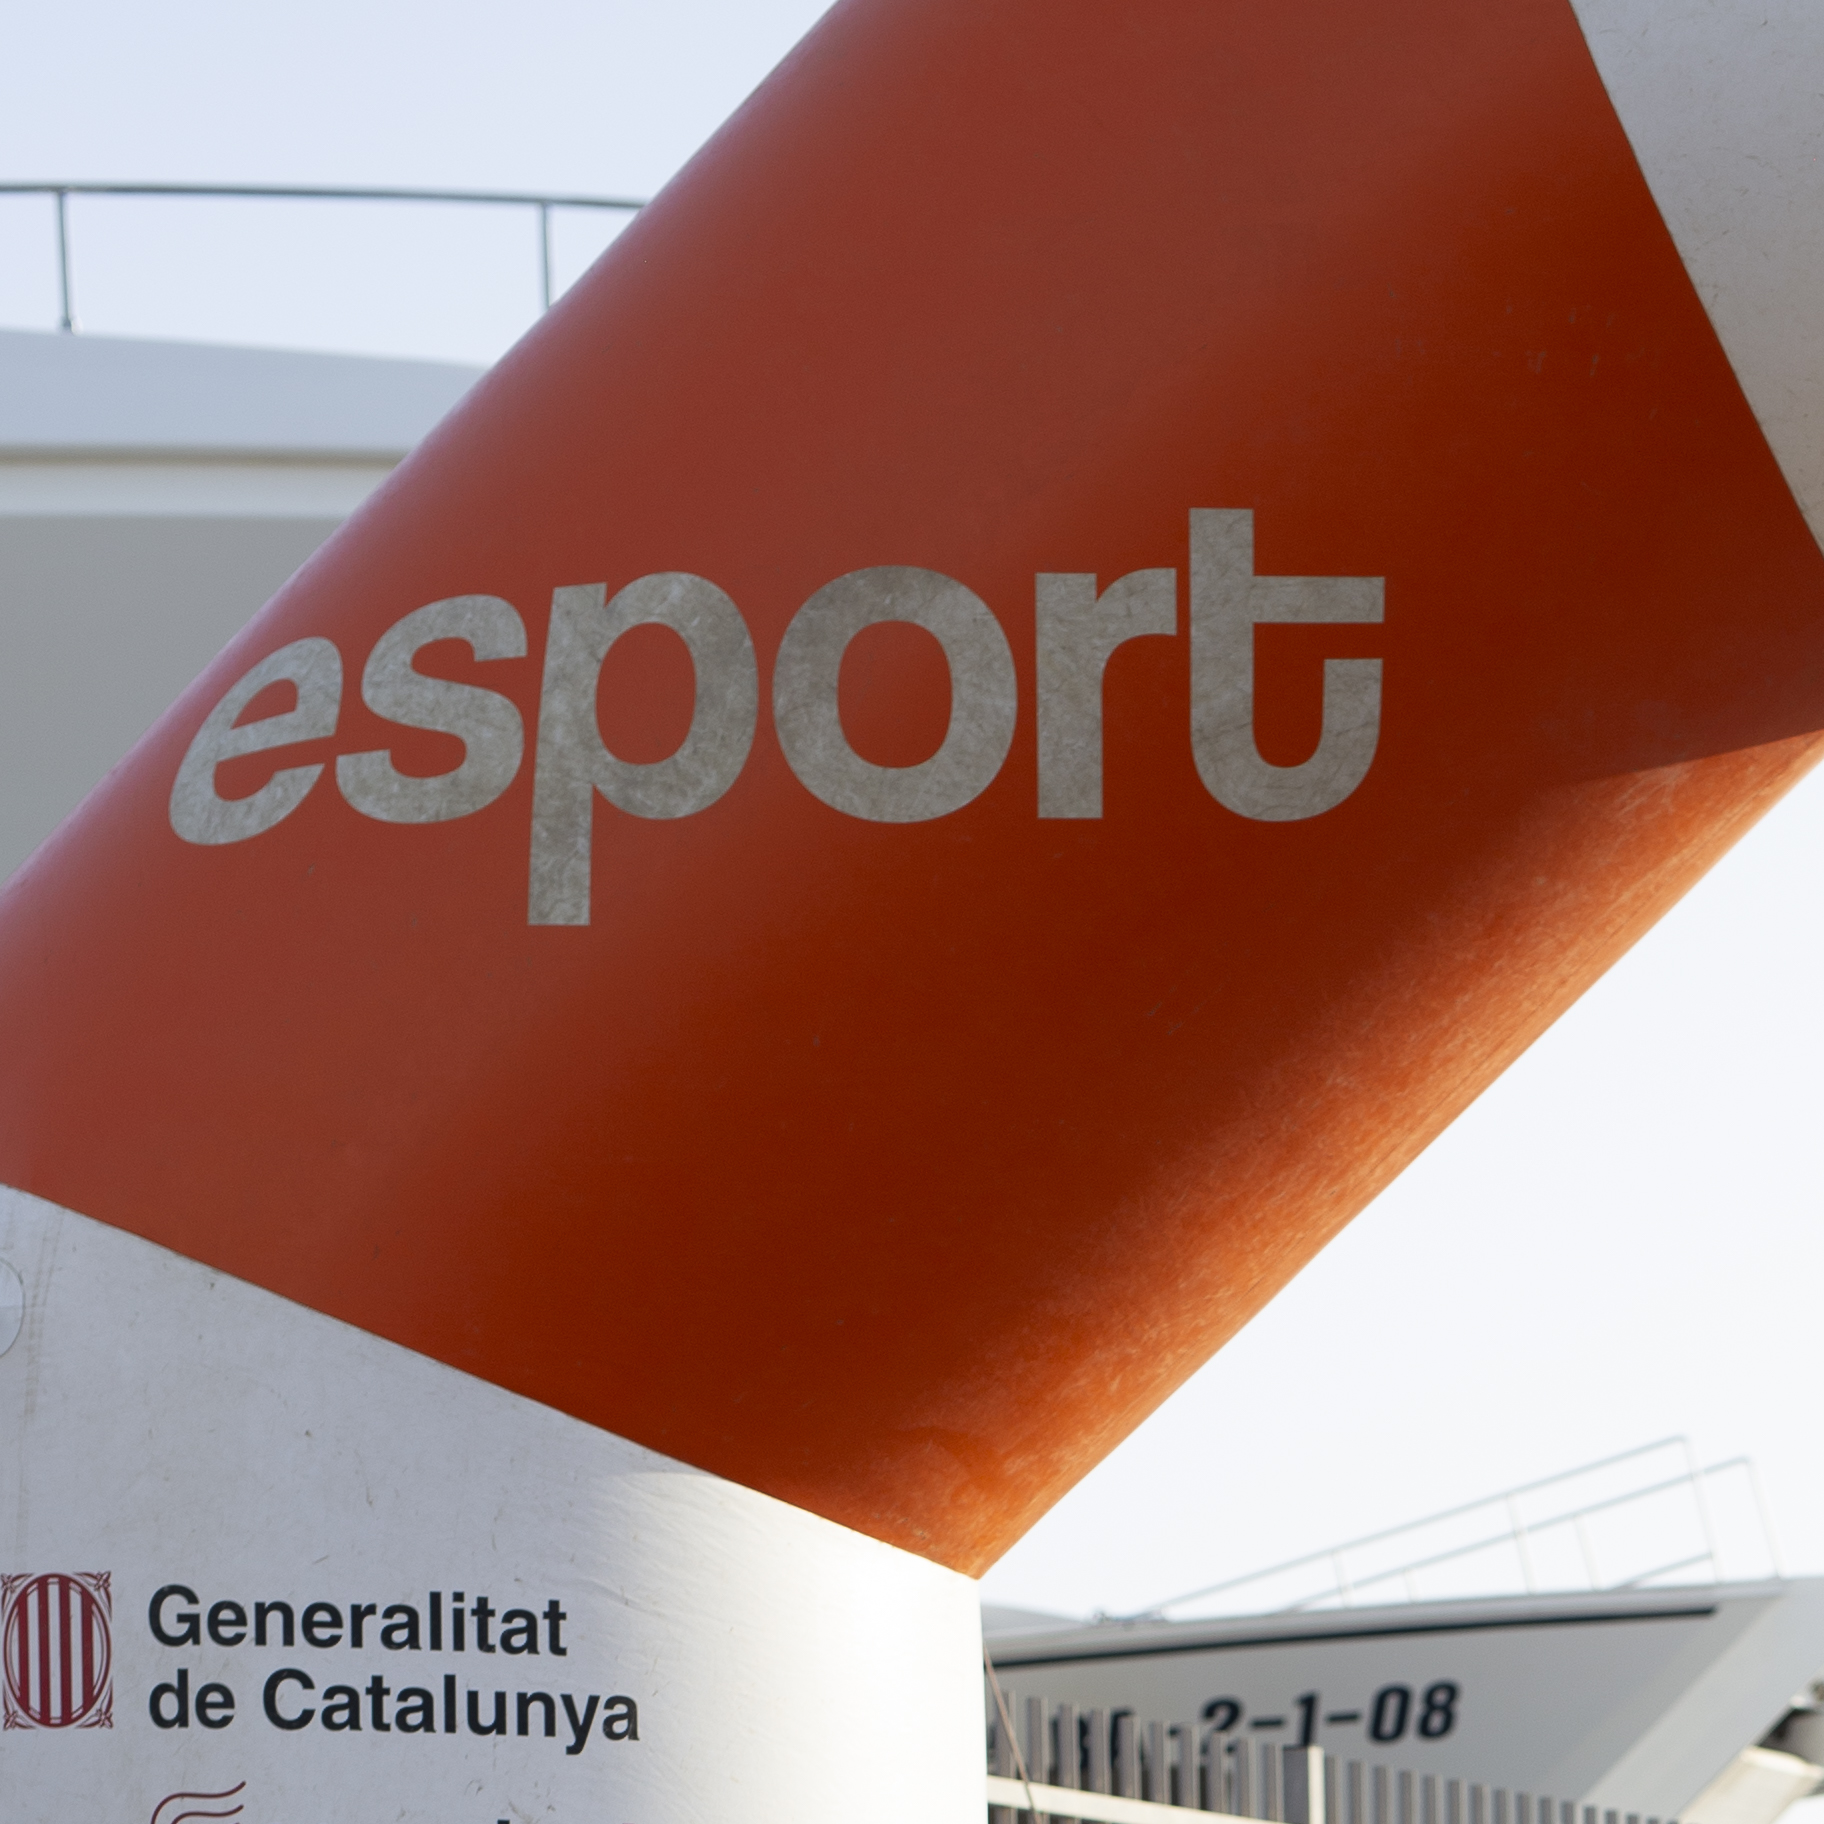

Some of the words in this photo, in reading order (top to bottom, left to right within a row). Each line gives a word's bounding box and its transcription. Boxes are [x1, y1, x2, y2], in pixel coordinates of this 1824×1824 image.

[168, 507, 1387, 927] esport
[148, 1584, 568, 1656] Generalitat
[148, 1669, 236, 1730] de
[262, 1669, 641, 1755] Catalunya
